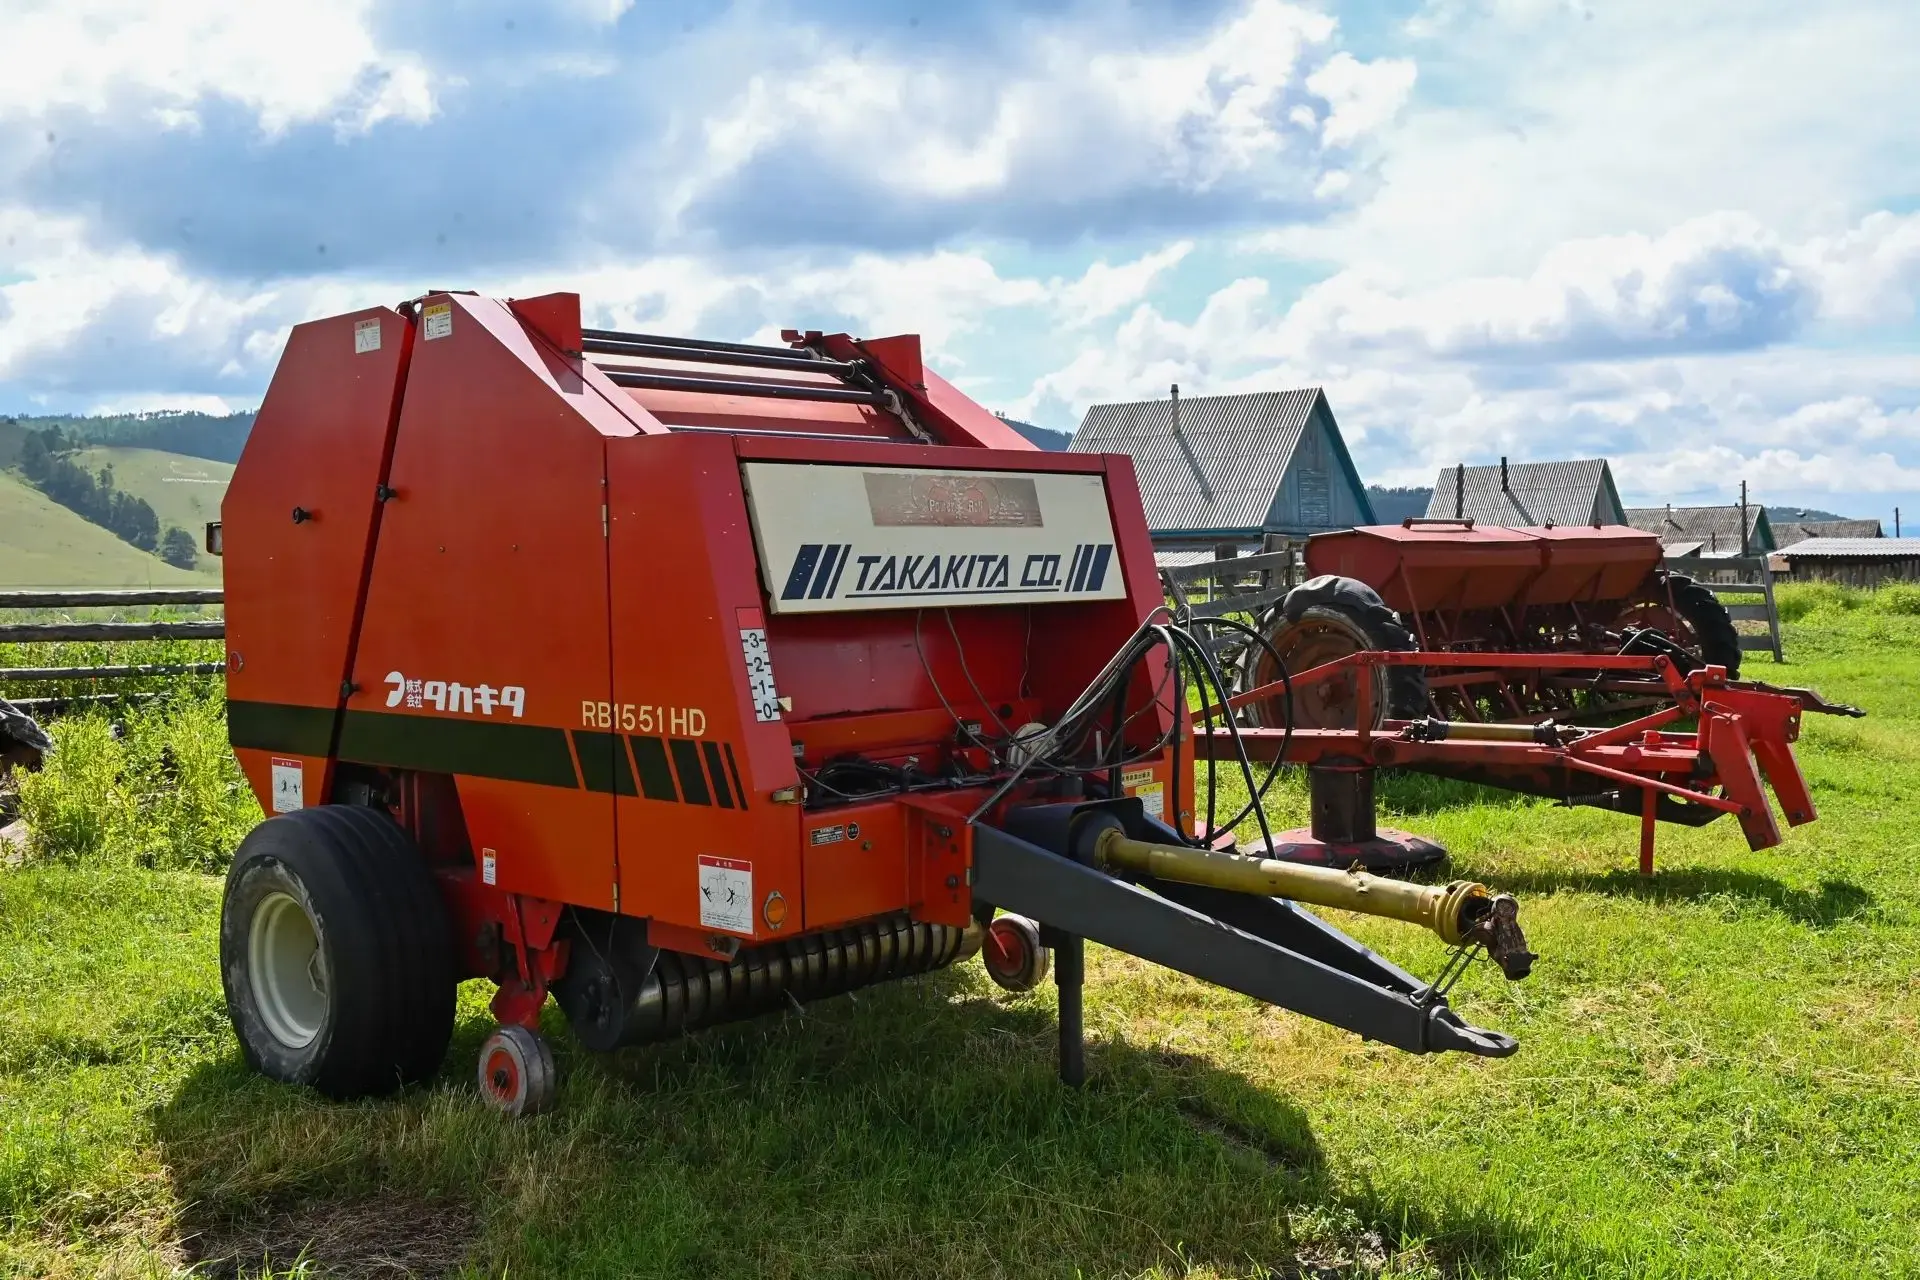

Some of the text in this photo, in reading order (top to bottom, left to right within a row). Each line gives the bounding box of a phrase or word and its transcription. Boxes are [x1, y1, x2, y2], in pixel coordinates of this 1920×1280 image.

[855, 554, 1062, 591] TAKAKITA CO.
[749, 632, 760, 648] 3
[753, 656, 765, 672] 2
[758, 680, 766, 695] 1
[762, 702, 773, 719] 0
